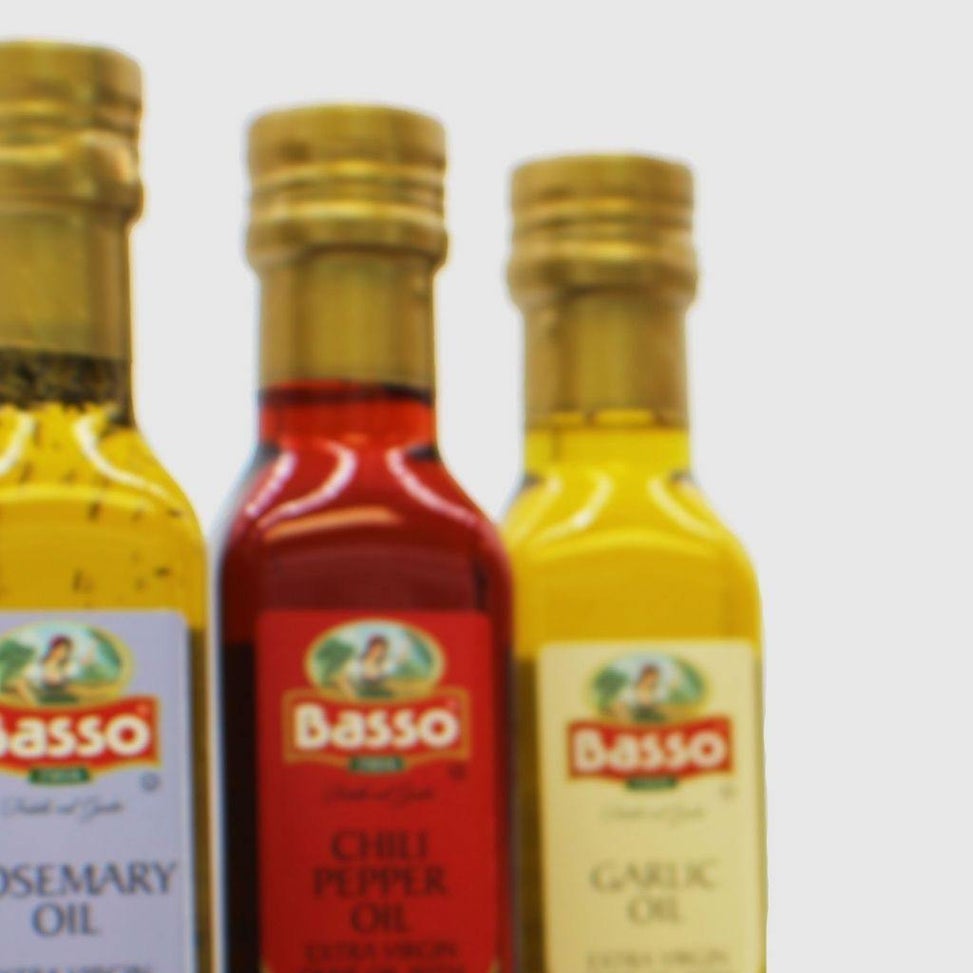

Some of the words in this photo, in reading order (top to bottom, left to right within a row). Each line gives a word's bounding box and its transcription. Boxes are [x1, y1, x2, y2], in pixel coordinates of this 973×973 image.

[0, 714, 151, 759] asso
[293, 702, 460, 751] Basso
[573, 729, 728, 773] Basso
[312, 866, 448, 896] PEPPER
[31, 902, 99, 936] OIL
[351, 901, 412, 934] OIL
